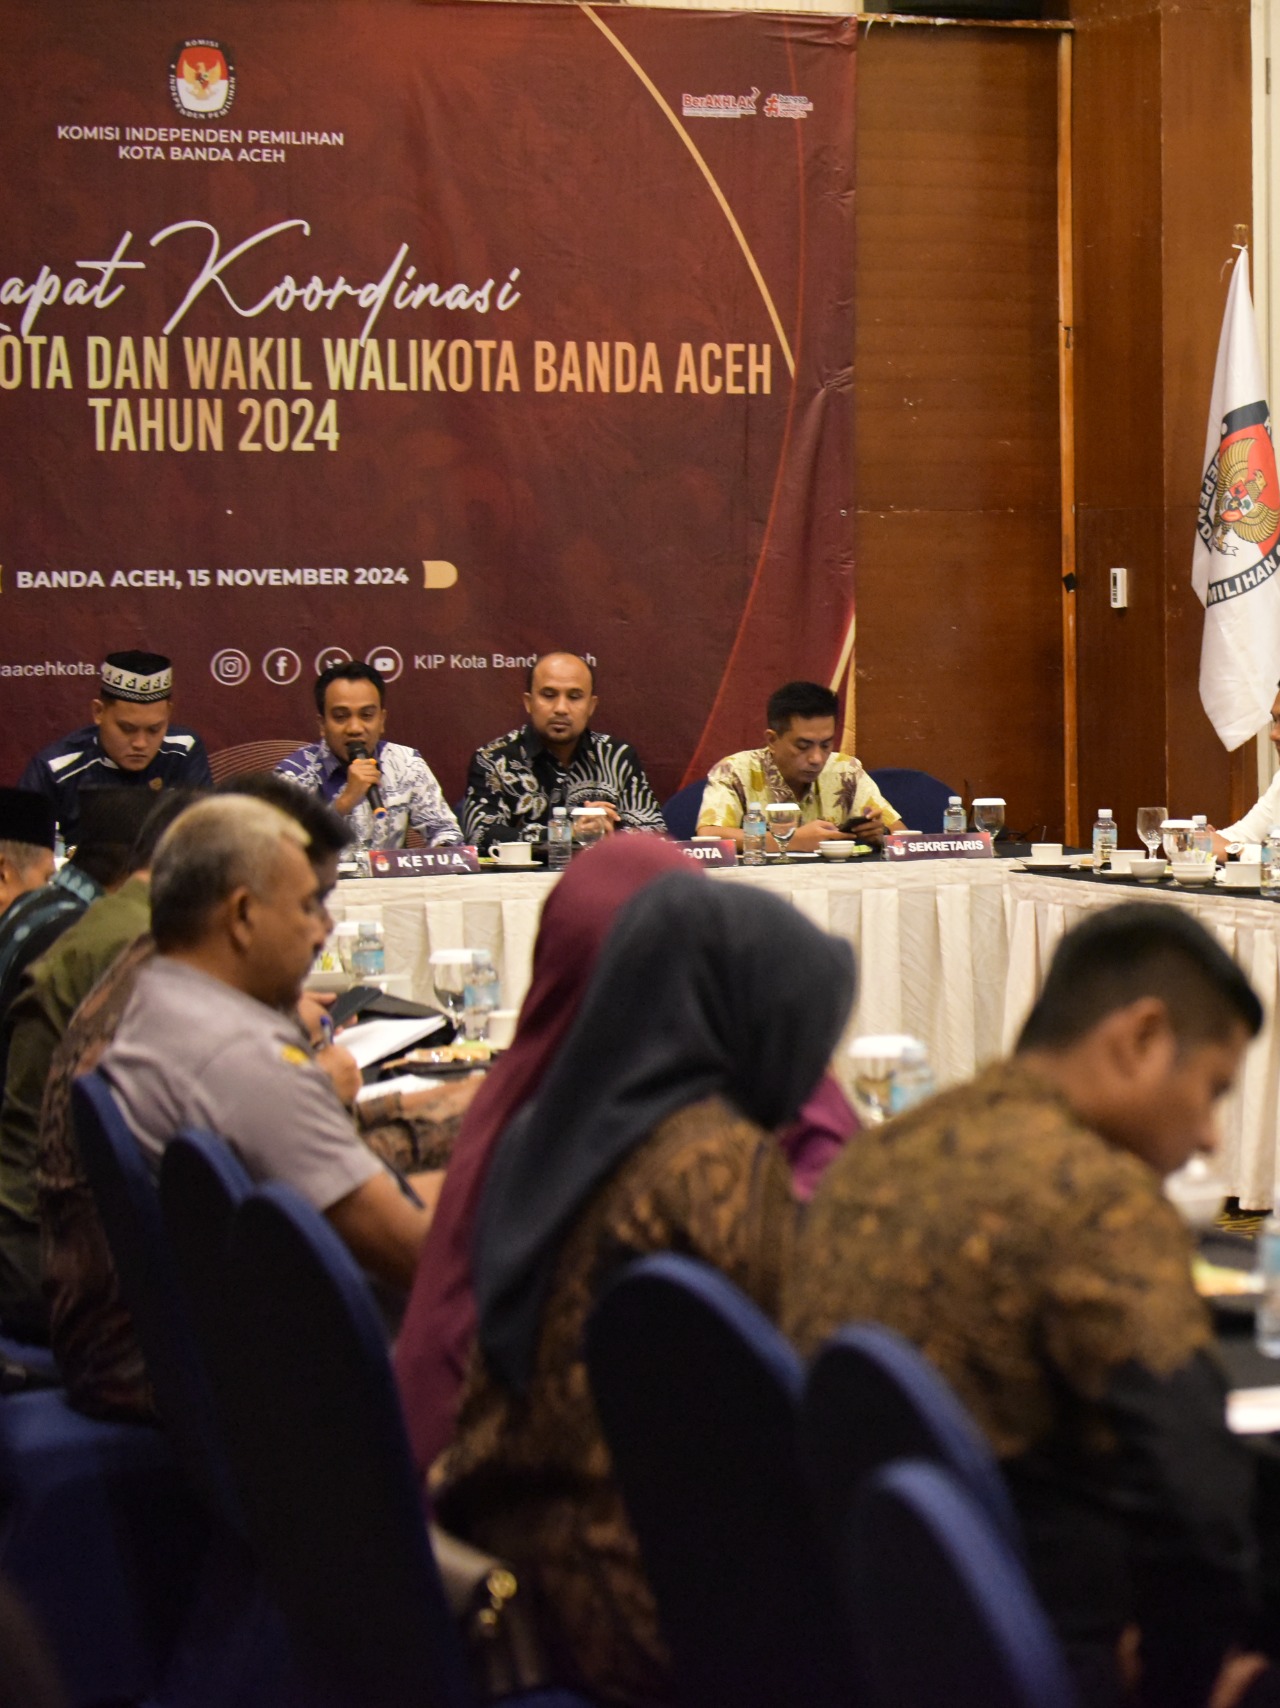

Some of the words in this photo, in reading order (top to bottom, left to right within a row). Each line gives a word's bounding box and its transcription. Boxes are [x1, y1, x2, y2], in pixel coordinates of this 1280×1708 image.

[57, 126, 120, 141] KOMISI
[125, 127, 243, 143] INDEPENDEN
[248, 130, 344, 146] PEMILIHAN
[118, 146, 165, 160] KOTA
[170, 147, 233, 161] BANDA
[237, 148, 286, 163] ACEH
[0, 231, 146, 337] apat
[149, 219, 521, 348] Koordinasi
[87, 336, 169, 390] DAN
[183, 336, 312, 390] WAKIL
[322, 338, 520, 392] WALIKOTA
[534, 340, 663, 394] BANDA
[674, 342, 772, 395] ACEH
[88, 398, 224, 451] TAHUN
[238, 399, 340, 452] 2024
[16, 570, 105, 588] BANDA
[110, 569, 182, 590] ACEH,
[187, 568, 211, 587] 15
[216, 568, 348, 586] NOVEMBER
[354, 567, 409, 585] 2024
[414, 655, 446, 669] KIP
[450, 654, 487, 669] Kota
[492, 653, 537, 668] Band
[908, 840, 984, 852] SEKRETARIS
[397, 853, 464, 868] KETUA
